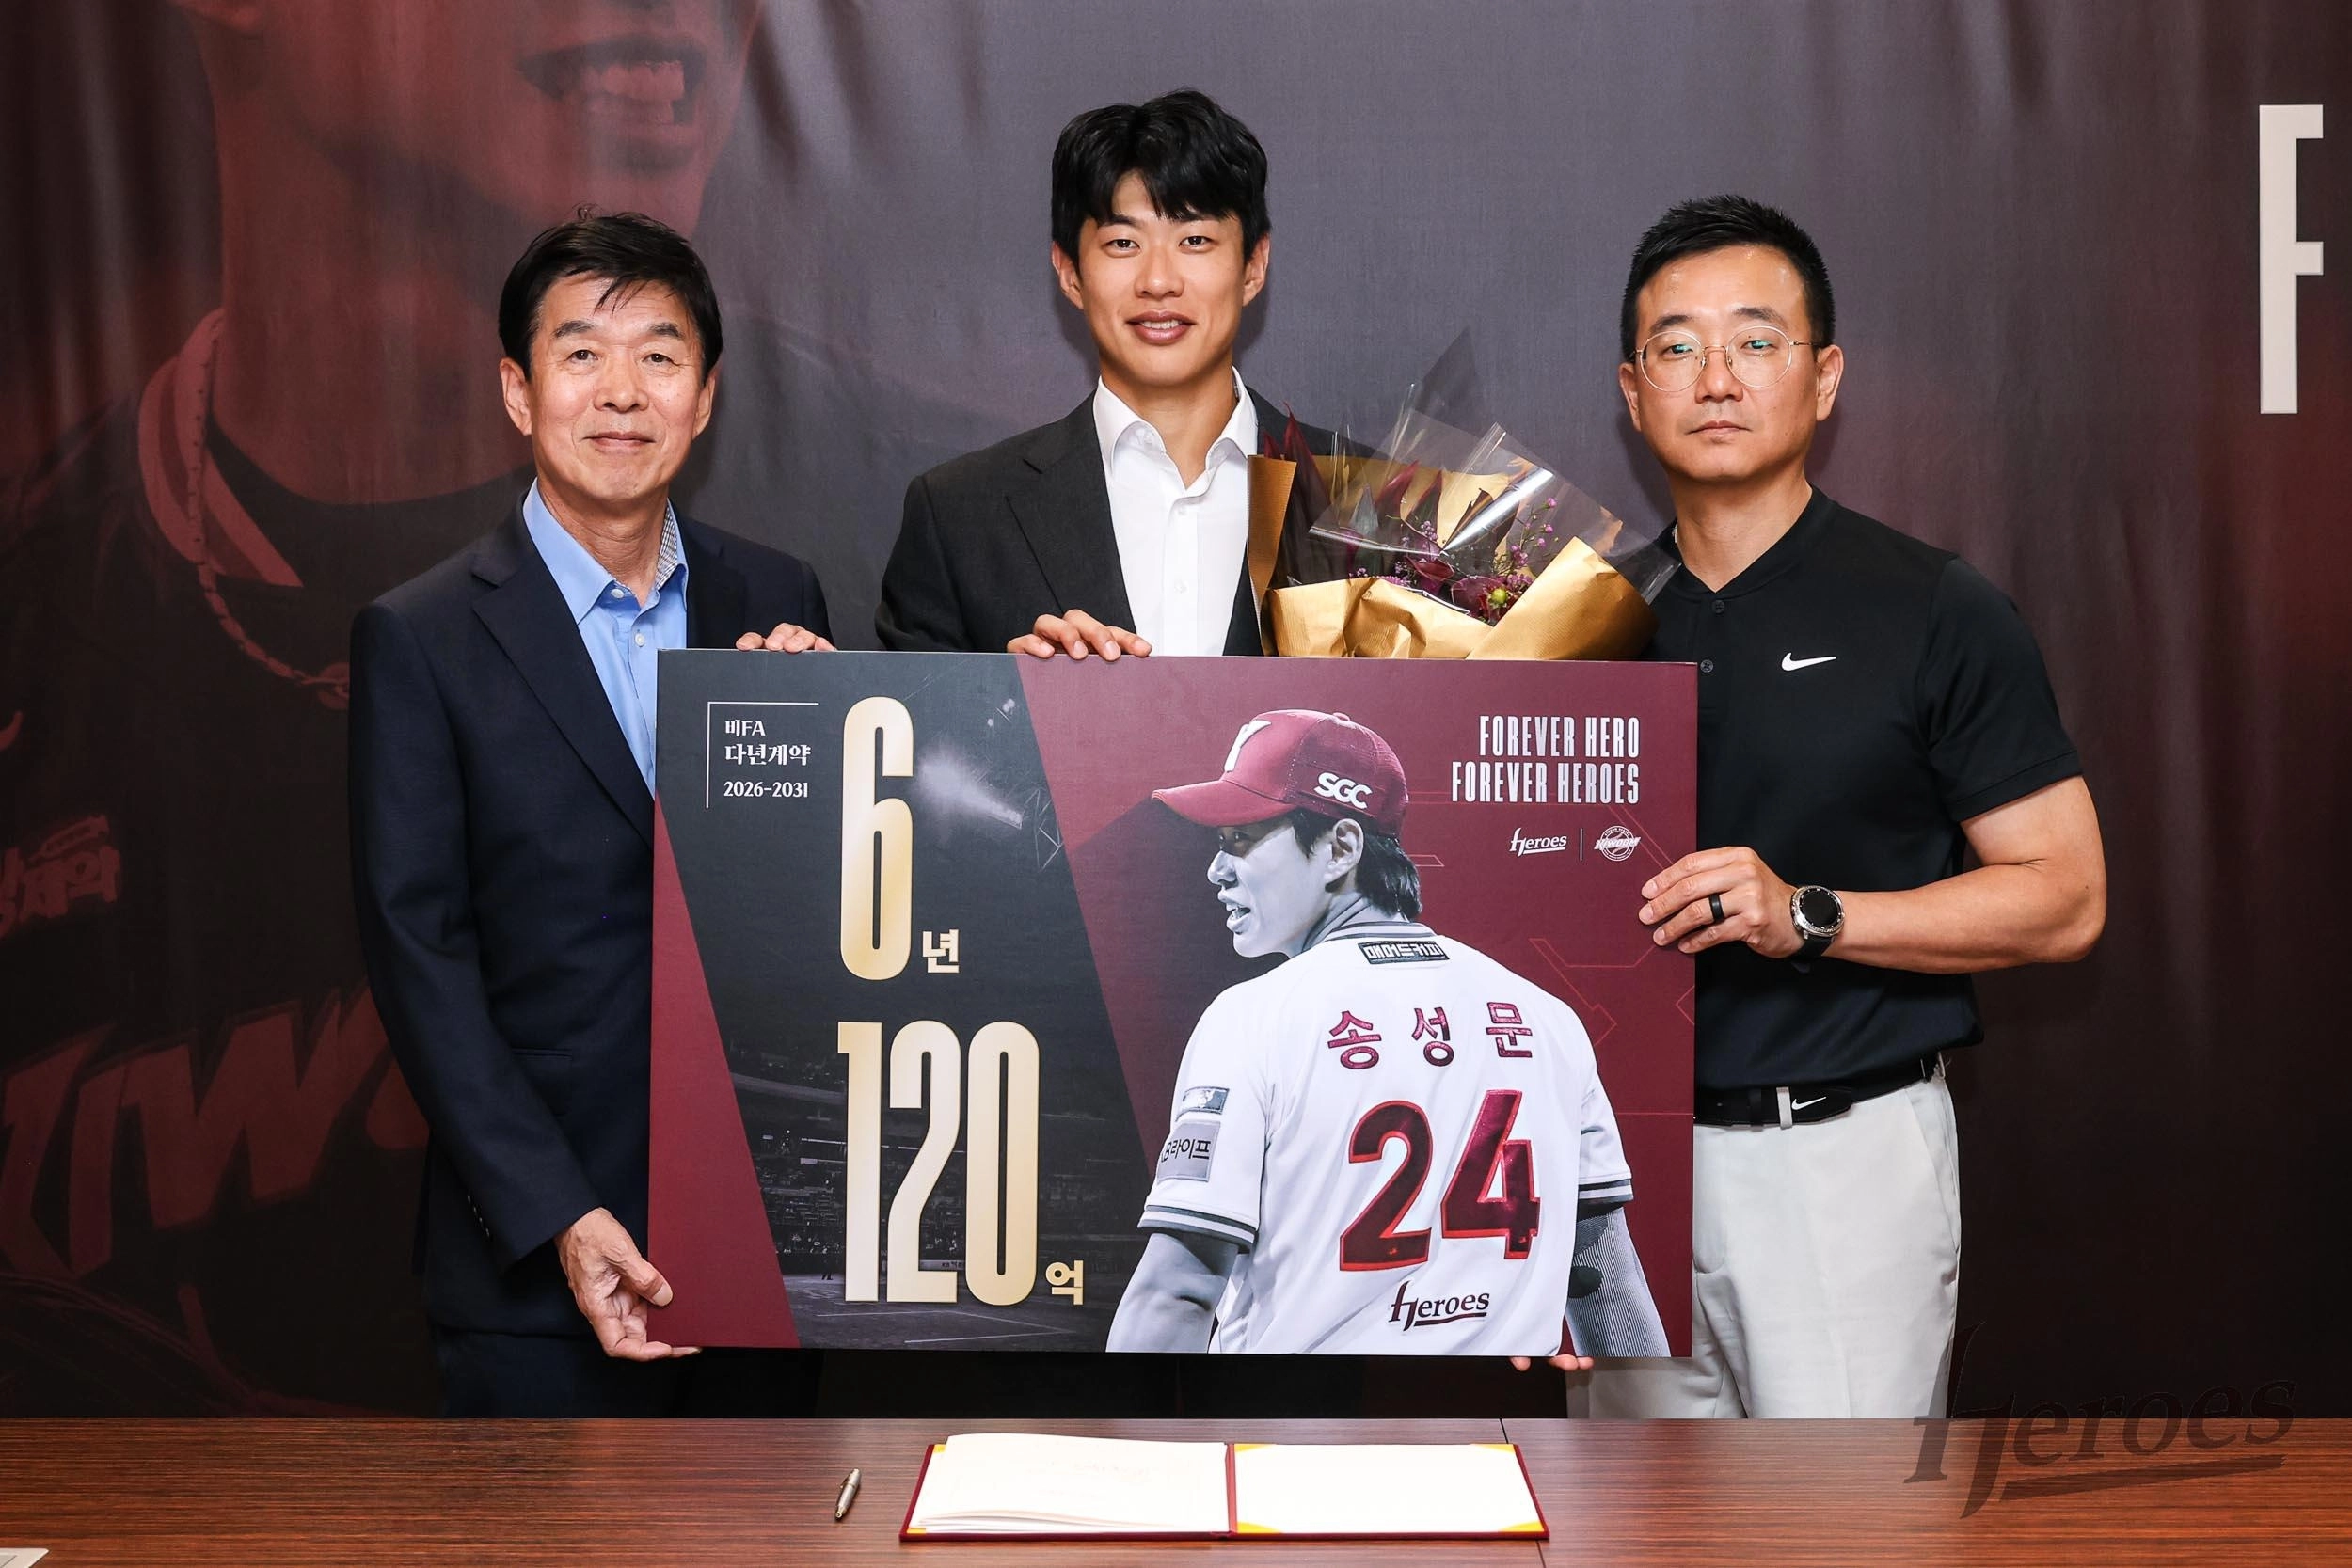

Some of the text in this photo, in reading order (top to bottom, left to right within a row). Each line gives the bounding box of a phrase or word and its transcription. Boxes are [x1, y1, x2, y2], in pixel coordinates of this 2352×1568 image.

[2259, 104, 2324, 414] F
[724, 719, 766, 737] 비FA
[1479, 715, 1640, 758] FOREVER HERO
[723, 743, 812, 766] 다년계약
[723, 781, 809, 798] 2026-2031
[1313, 771, 1373, 809] SGC
[1452, 761, 1640, 804] FOREVER HEROES
[1340, 1089, 1541, 1272] 24
